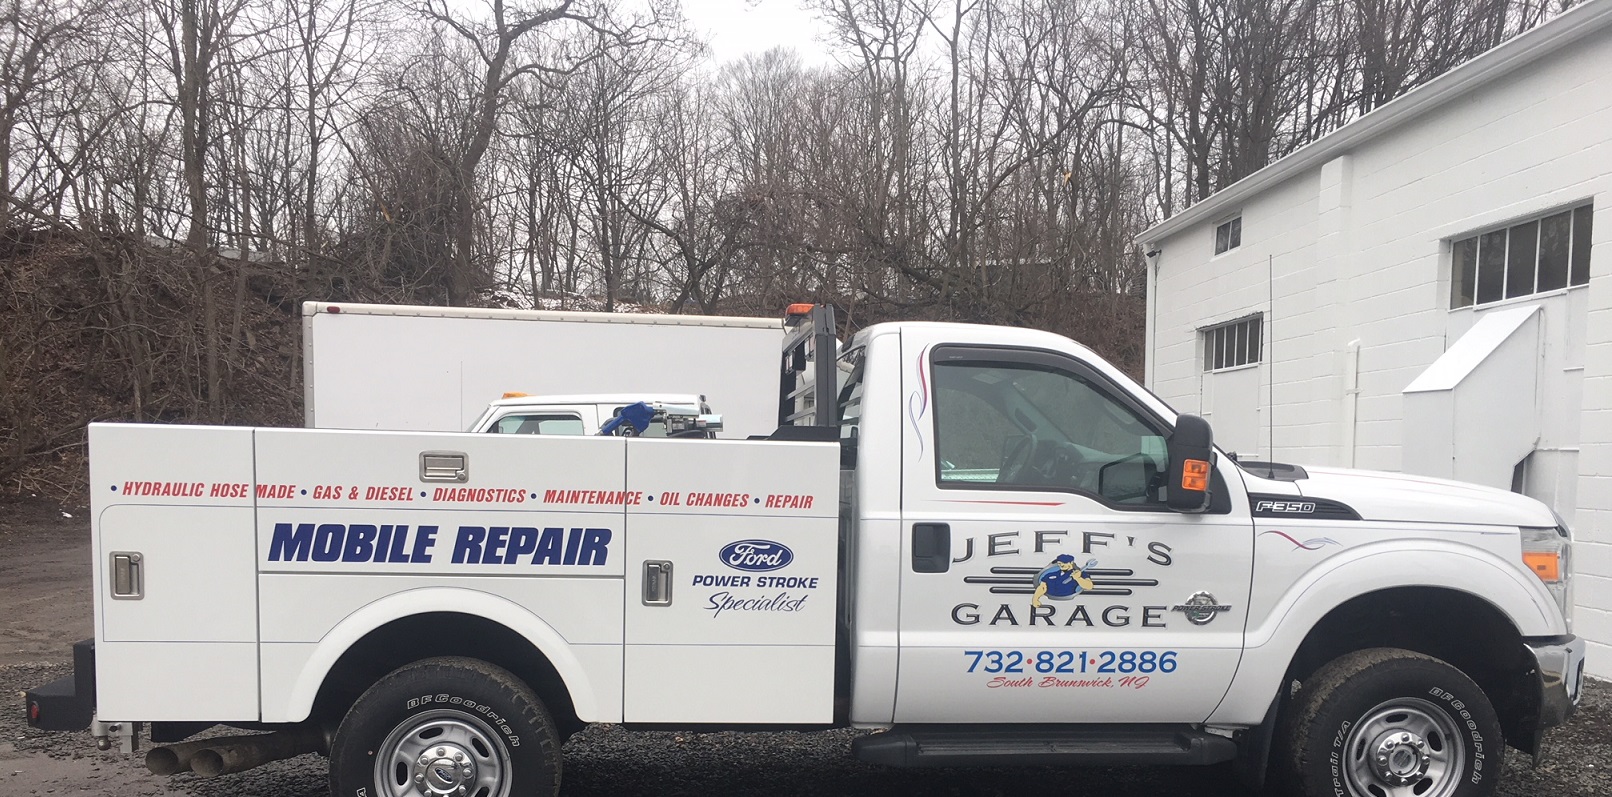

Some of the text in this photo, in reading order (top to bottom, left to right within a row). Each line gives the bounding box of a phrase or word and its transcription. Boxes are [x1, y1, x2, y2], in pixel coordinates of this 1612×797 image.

[122, 481, 815, 510] HYDRAULIC HOSE MADE GAS & DIESEL DIAGNOSTICS MAINTENANCE OIL CHANGES REPAIR
[267, 522, 613, 566] MOBILE REPAIR
[729, 543, 784, 566] Ford
[952, 529, 1173, 566] JEFF'S
[692, 575, 819, 589] POWER STROKE
[704, 591, 806, 618] Specialist
[950, 601, 1168, 628] GARAGE
[987, 675, 1150, 690] South Brunswick, NJ
[407, 694, 521, 748] BFGoodrich
[1333, 720, 1351, 748] T/A
[1429, 687, 1485, 785] BFGoodrich
